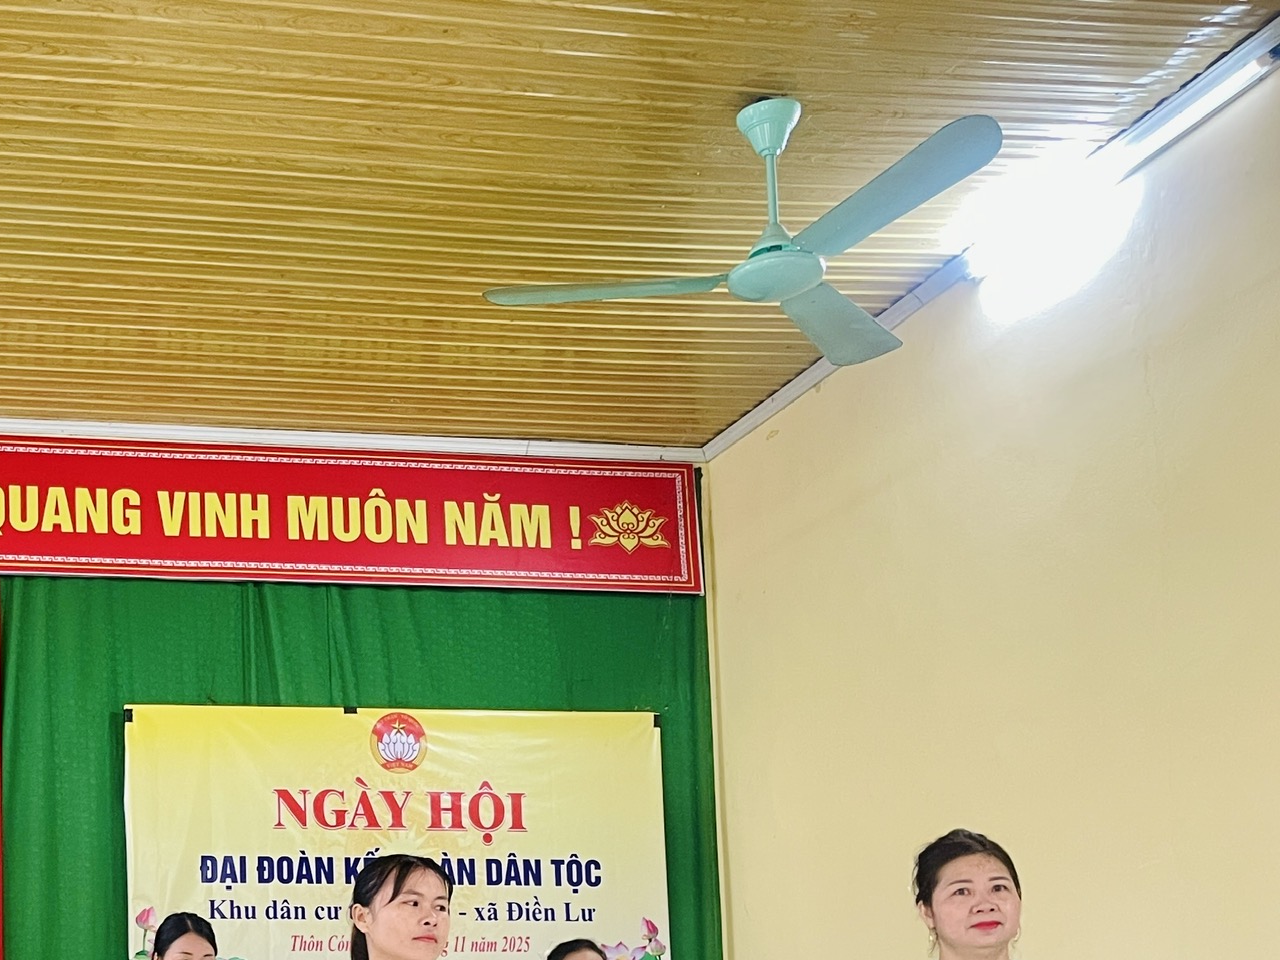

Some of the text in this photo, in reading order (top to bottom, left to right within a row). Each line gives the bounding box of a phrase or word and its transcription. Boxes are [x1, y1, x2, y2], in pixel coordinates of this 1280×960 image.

[157, 490, 270, 539] VINH
[286, 488, 428, 544] MUÔN
[444, 492, 552, 549] NĂM
[568, 505, 582, 550] !
[273, 776, 528, 846] NGÀY HỘI
[199, 855, 247, 891] ĐẠI
[256, 850, 335, 885] ĐOÀN
[439, 851, 476, 886] ÀN
[485, 852, 542, 887] DÂN
[550, 853, 602, 894] TỘC
[208, 899, 257, 920] Khu
[265, 899, 306, 920] dân
[314, 905, 342, 920] cư
[474, 902, 499, 922] xã
[506, 896, 556, 922] Điền
[564, 902, 596, 922] Lư
[291, 934, 323, 951] Thôn
[454, 936, 466, 952] 11
[471, 937, 497, 952] năm
[502, 936, 530, 952] 2025
